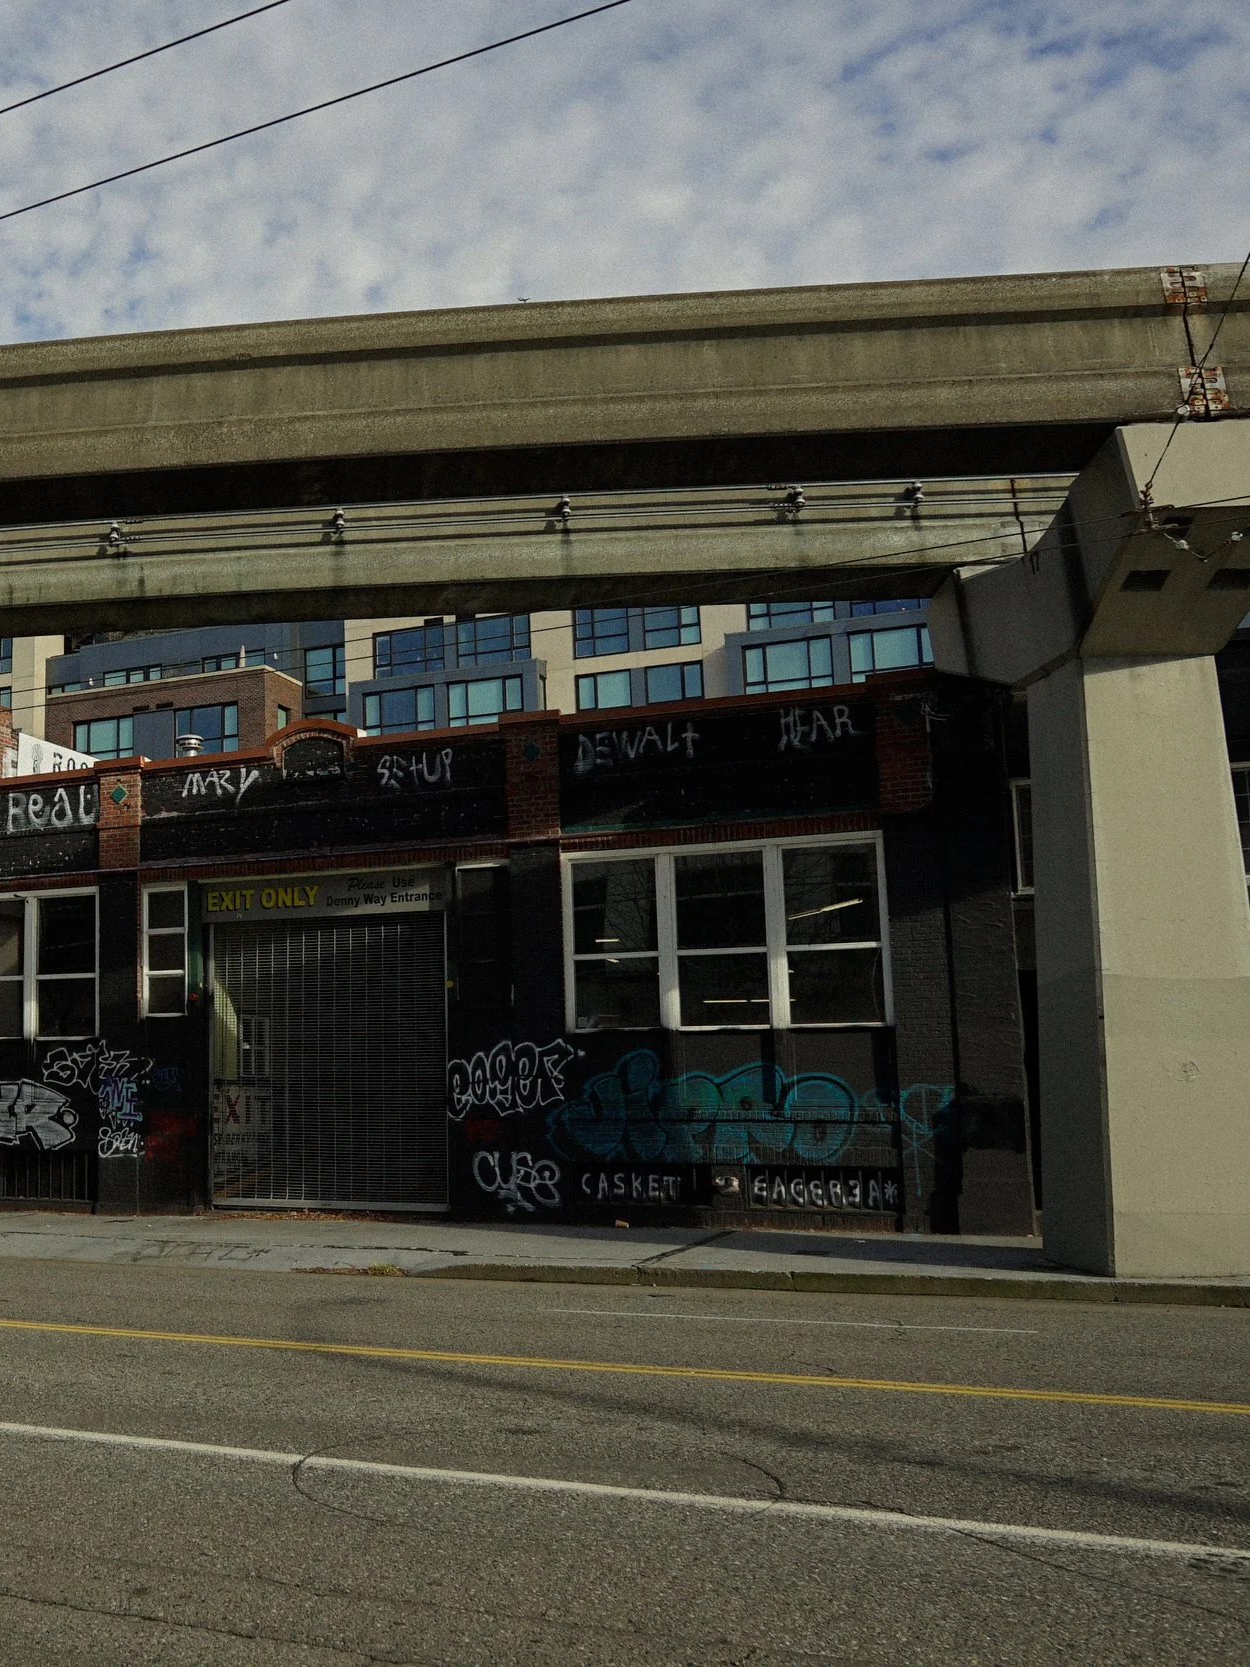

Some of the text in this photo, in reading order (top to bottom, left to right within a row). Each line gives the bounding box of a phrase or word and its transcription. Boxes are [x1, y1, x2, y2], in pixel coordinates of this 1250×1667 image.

[348, 877, 415, 892] Please Use
[206, 885, 320, 913] EXIT ONLY
[326, 890, 443, 908] Denny Way Entrance
[581, 1171, 681, 1200] CASKET
